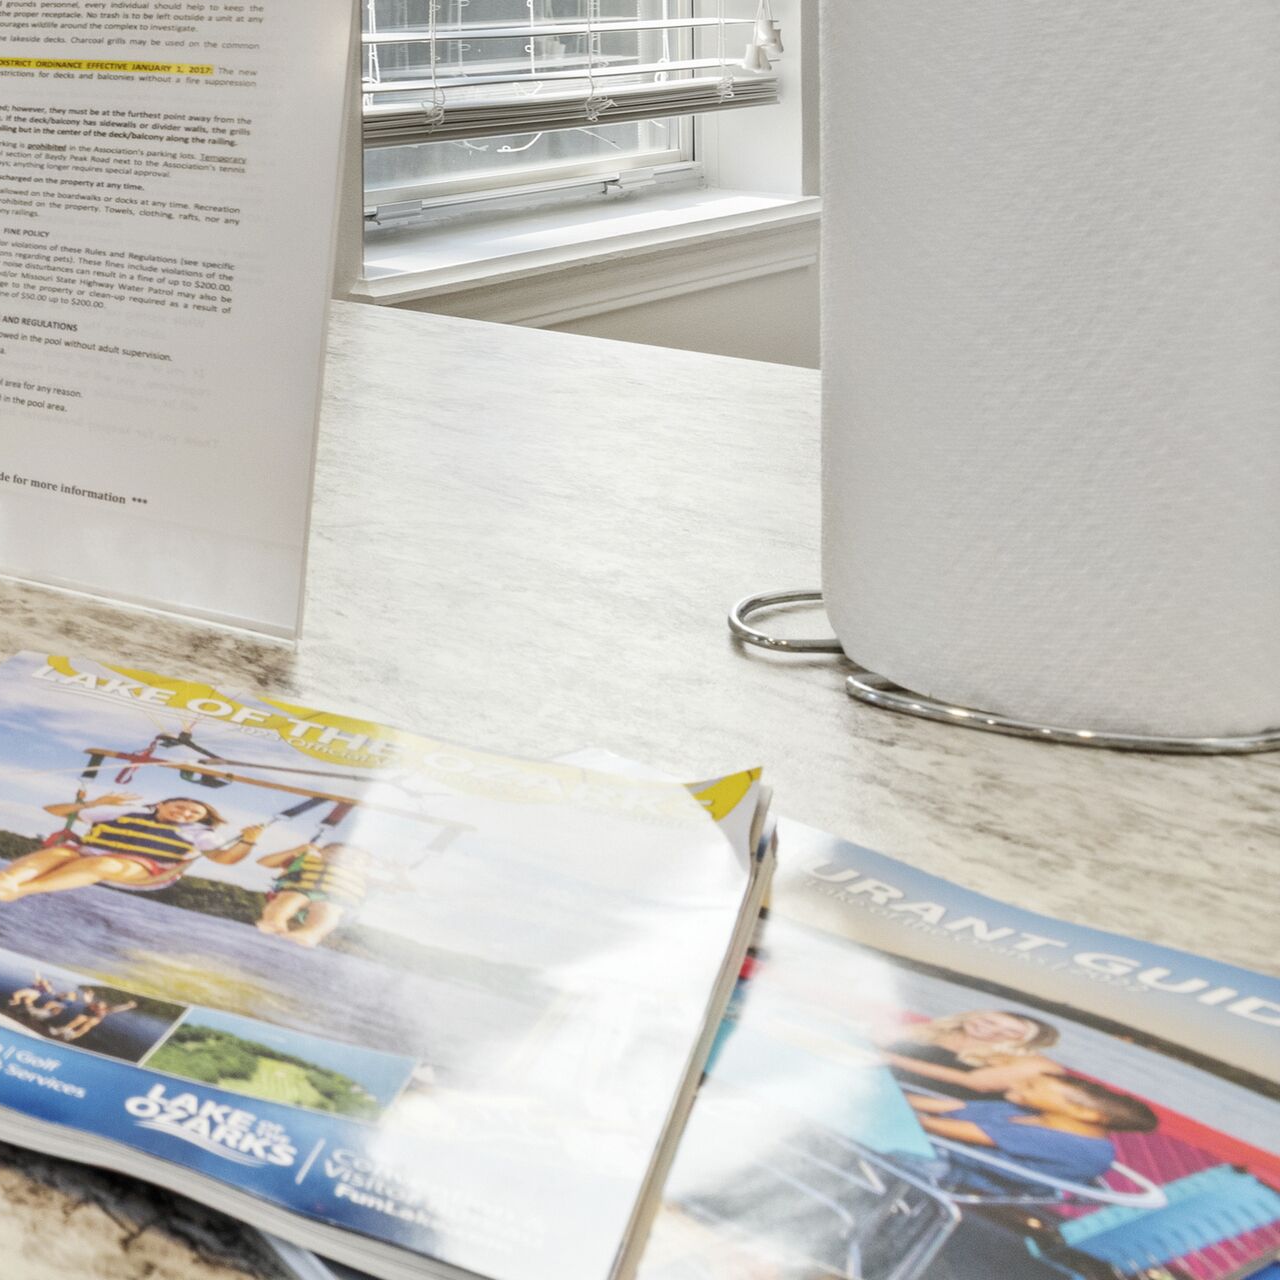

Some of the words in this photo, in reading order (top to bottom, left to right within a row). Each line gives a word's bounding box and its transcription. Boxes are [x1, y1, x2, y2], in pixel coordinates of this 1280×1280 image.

[34, 60, 82, 69] ORDINANCE
[85, 61, 128, 70] EFFECTIVE
[131, 63, 171, 71] JANUARY
[59, 178, 94, 187] property
[105, 182, 121, 190] any
[3, 227, 20, 235] FINE
[22, 228, 50, 238] POLICY
[1, 315, 20, 324] AND
[20, 316, 78, 332] REGULATIONS
[12, 474, 27, 485] for
[29, 479, 58, 491] more
[59, 483, 126, 504] information
[30, 664, 177, 708] LAKE
[186, 696, 272, 730] OF
[15, 1049, 62, 1072] Golf
[4, 1062, 87, 1099] Services
[146, 1083, 258, 1134] LAKE
[124, 1096, 298, 1167] OZARKS
